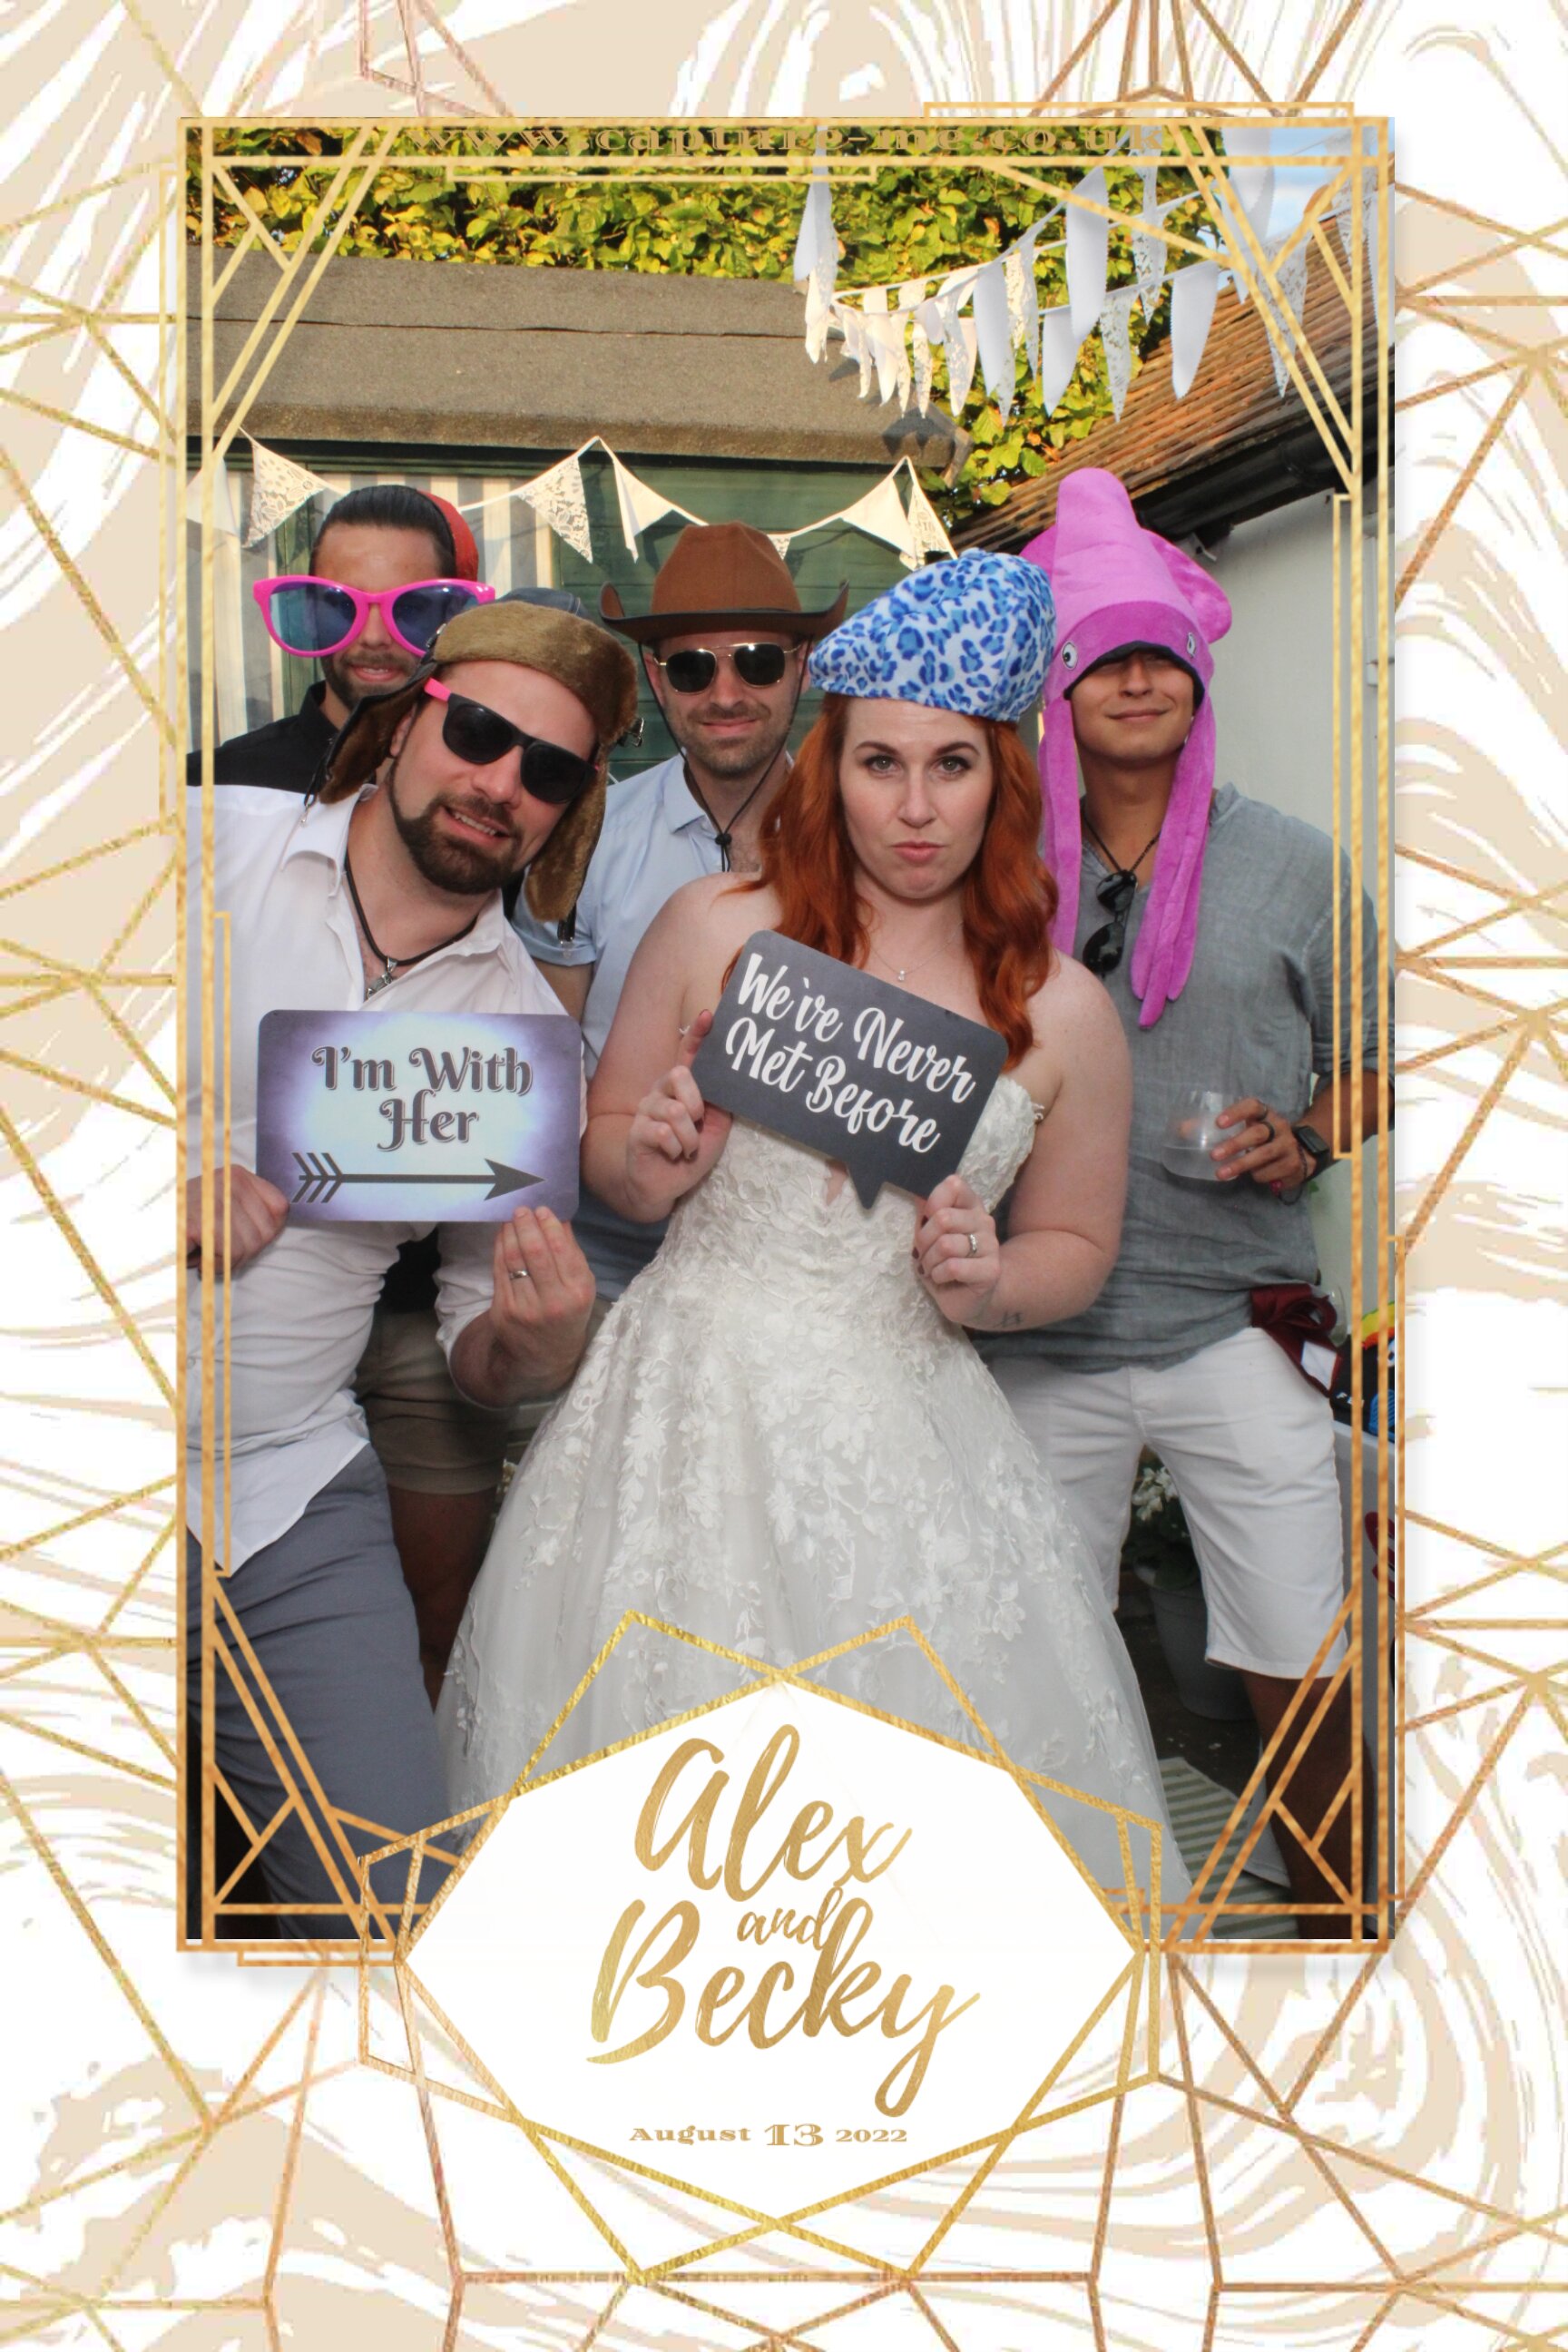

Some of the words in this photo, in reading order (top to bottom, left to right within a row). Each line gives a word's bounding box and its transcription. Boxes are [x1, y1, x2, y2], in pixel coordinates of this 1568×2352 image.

[310, 1044, 397, 1092] I'm
[407, 1046, 533, 1096] With
[725, 1017, 814, 1093] Met
[805, 1055, 942, 1153] Before
[853, 1007, 976, 1103] Never
[376, 1089, 479, 1152] Her
